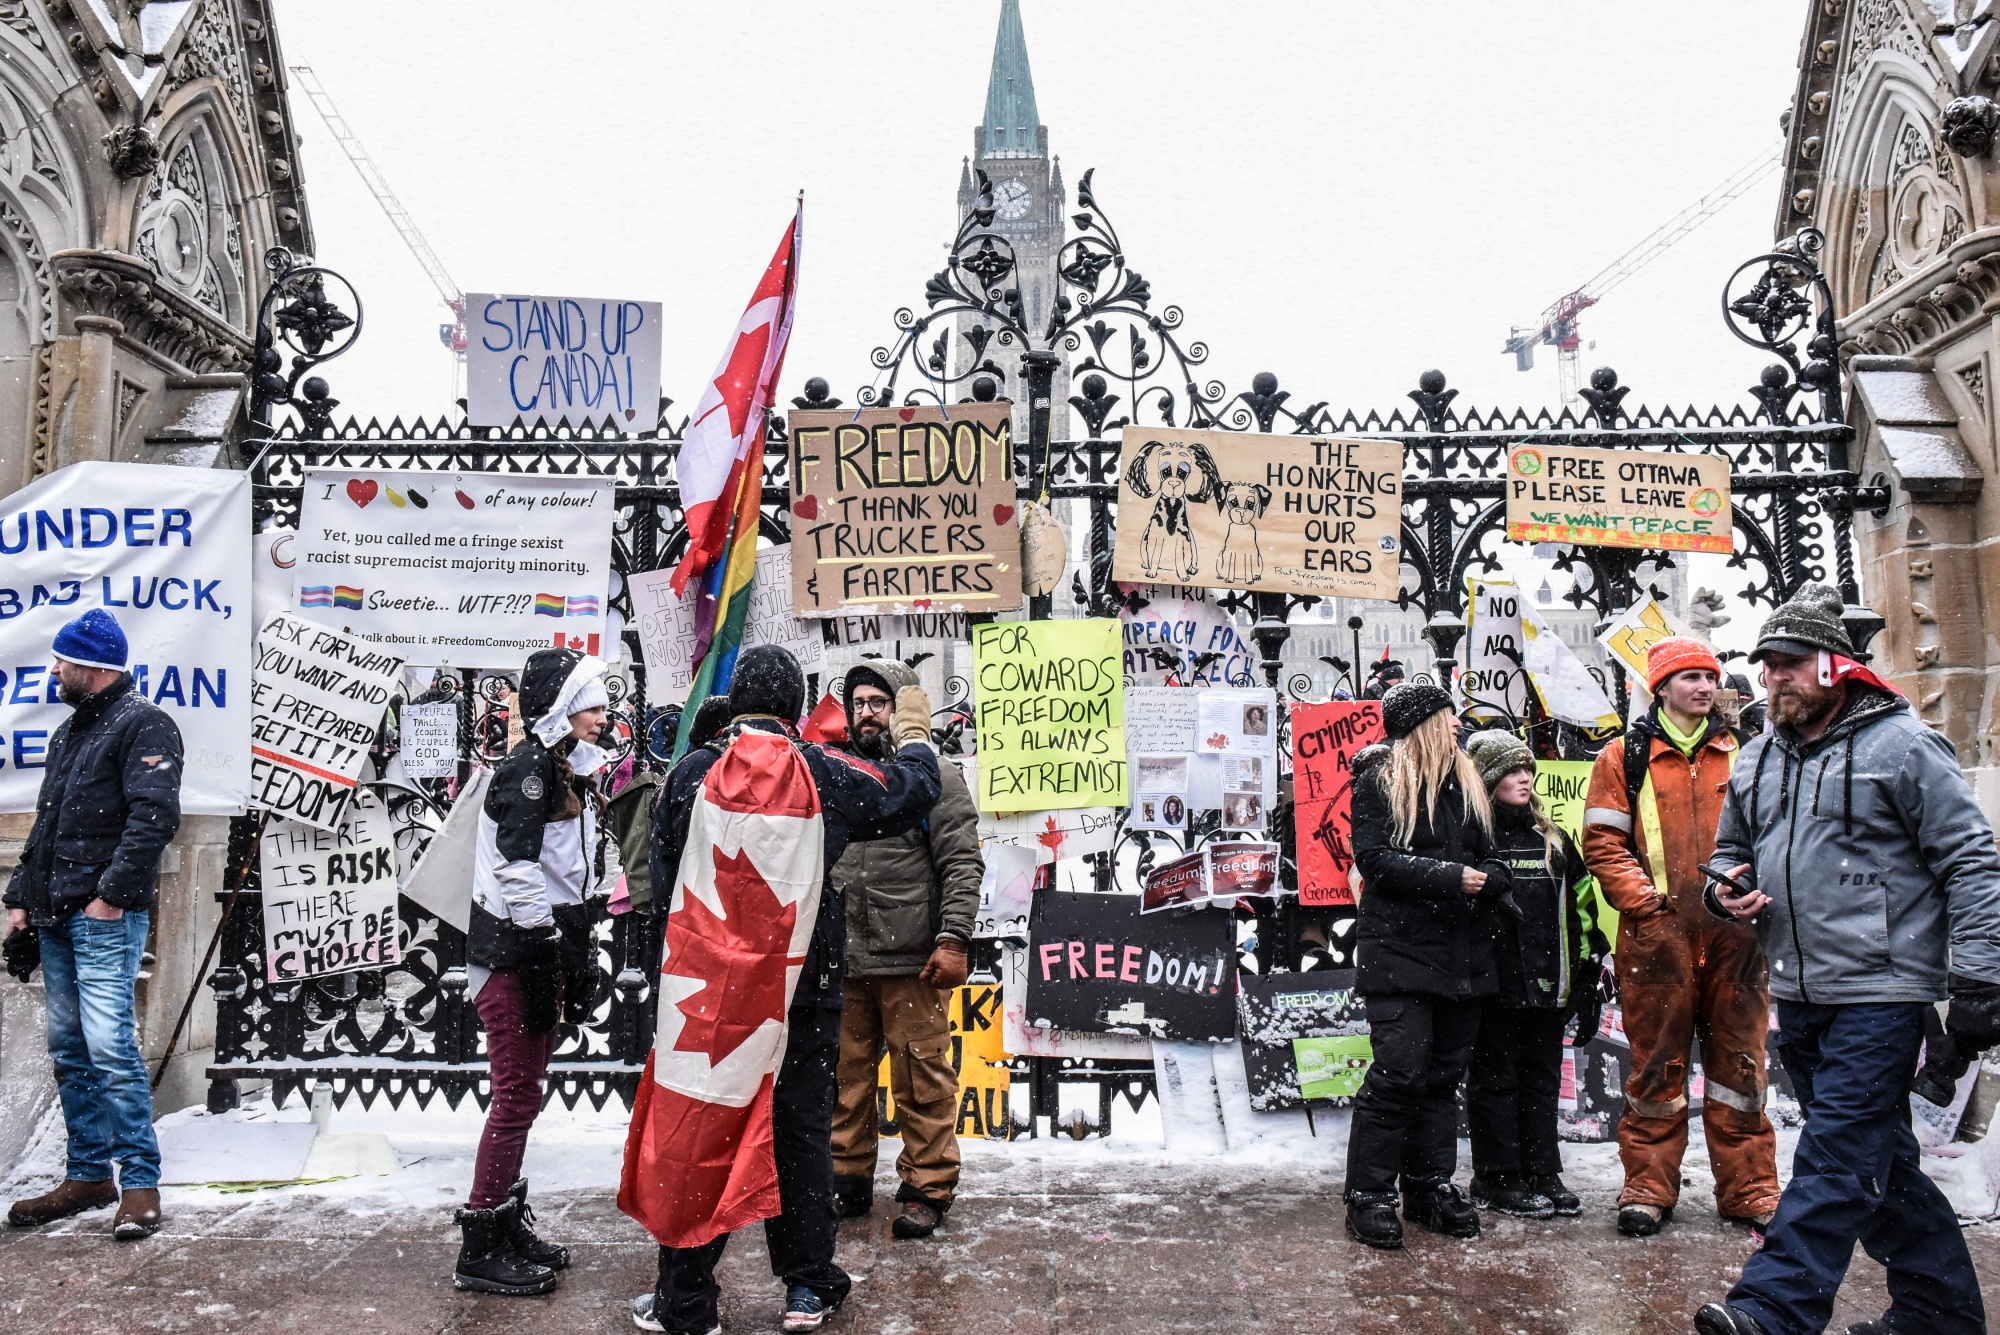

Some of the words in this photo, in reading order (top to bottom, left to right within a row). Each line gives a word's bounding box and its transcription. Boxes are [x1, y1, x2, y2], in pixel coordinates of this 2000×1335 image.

[483, 298, 587, 352] STAND
[600, 302, 644, 355] UP
[509, 352, 635, 414] CANADA!
[793, 418, 1012, 496] FREEDOM
[1310, 441, 1360, 468] THE
[1266, 462, 1396, 495] HONKING
[1547, 456, 1605, 480] FREE
[1618, 462, 1702, 487] OTTAWA
[321, 484, 336, 500] I
[485, 489, 505, 508] of
[506, 495, 536, 511] any
[541, 490, 598, 508] colour!
[938, 492, 977, 520] YOU
[1284, 491, 1377, 519] HURTS
[1512, 480, 1606, 504] PLEASE
[1621, 487, 1686, 508] LEAVE
[1304, 519, 1356, 544] OUR
[1530, 511, 1561, 525] WE
[1564, 512, 1625, 529] WANT
[1629, 516, 1714, 536] PEACE
[323, 529, 351, 544] Yet,
[354, 534, 383, 546] you
[386, 532, 430, 546] called
[435, 536, 456, 546] me
[459, 537, 468, 547] a
[471, 534, 518, 551] fringe
[520, 536, 564, 550] sexist
[807, 523, 985, 559] TRUCKERS
[306, 550, 351, 564] racist
[354, 554, 448, 569] supremacist
[451, 556, 516, 574] majority
[518, 558, 590, 576] minority.
[1273, 566, 1295, 576] But
[1295, 568, 1334, 583] Freedom
[1304, 548, 1372, 574] EARS
[101, 575, 233, 620] LUCK,
[368, 590, 450, 611] Sweetie...
[457, 593, 533, 615] WTF?!?
[1489, 597, 1518, 618] NO
[262, 617, 311, 646] ASK
[308, 631, 350, 660] FOR
[346, 644, 405, 678] WHAT
[384, 633, 416, 645] about
[418, 634, 429, 645] it.
[431, 635, 550, 650] #FreedomConvoy2022
[979, 625, 1037, 660] FOR
[1483, 634, 1515, 657] NO
[254, 642, 294, 675] YOU
[293, 660, 348, 692] WANT
[338, 679, 388, 705] AND
[979, 656, 1116, 697] COWARDS
[1479, 669, 1509, 692] NO
[271, 693, 376, 746] PREPARED
[401, 708, 413, 717] LE
[418, 707, 453, 717] PEUPLE
[981, 695, 1111, 729] FREEDOM
[982, 732, 1005, 752] IS
[1021, 727, 1109, 755] ALWAYS
[1297, 704, 1380, 759] Crimes
[404, 759, 425, 767] BLESS
[435, 758, 455, 768] YOU!
[415, 748, 440, 758] GOD
[265, 820, 372, 858] THERE
[272, 863, 317, 887] IS
[327, 846, 393, 887] RISK
[1838, 874, 1879, 887] FOX
[1304, 881, 1351, 901] Geneva
[267, 890, 359, 924] THERE
[360, 905, 397, 940] BE
[274, 935, 395, 979] CHOICE
[1039, 941, 1224, 995] FREEDOM!
